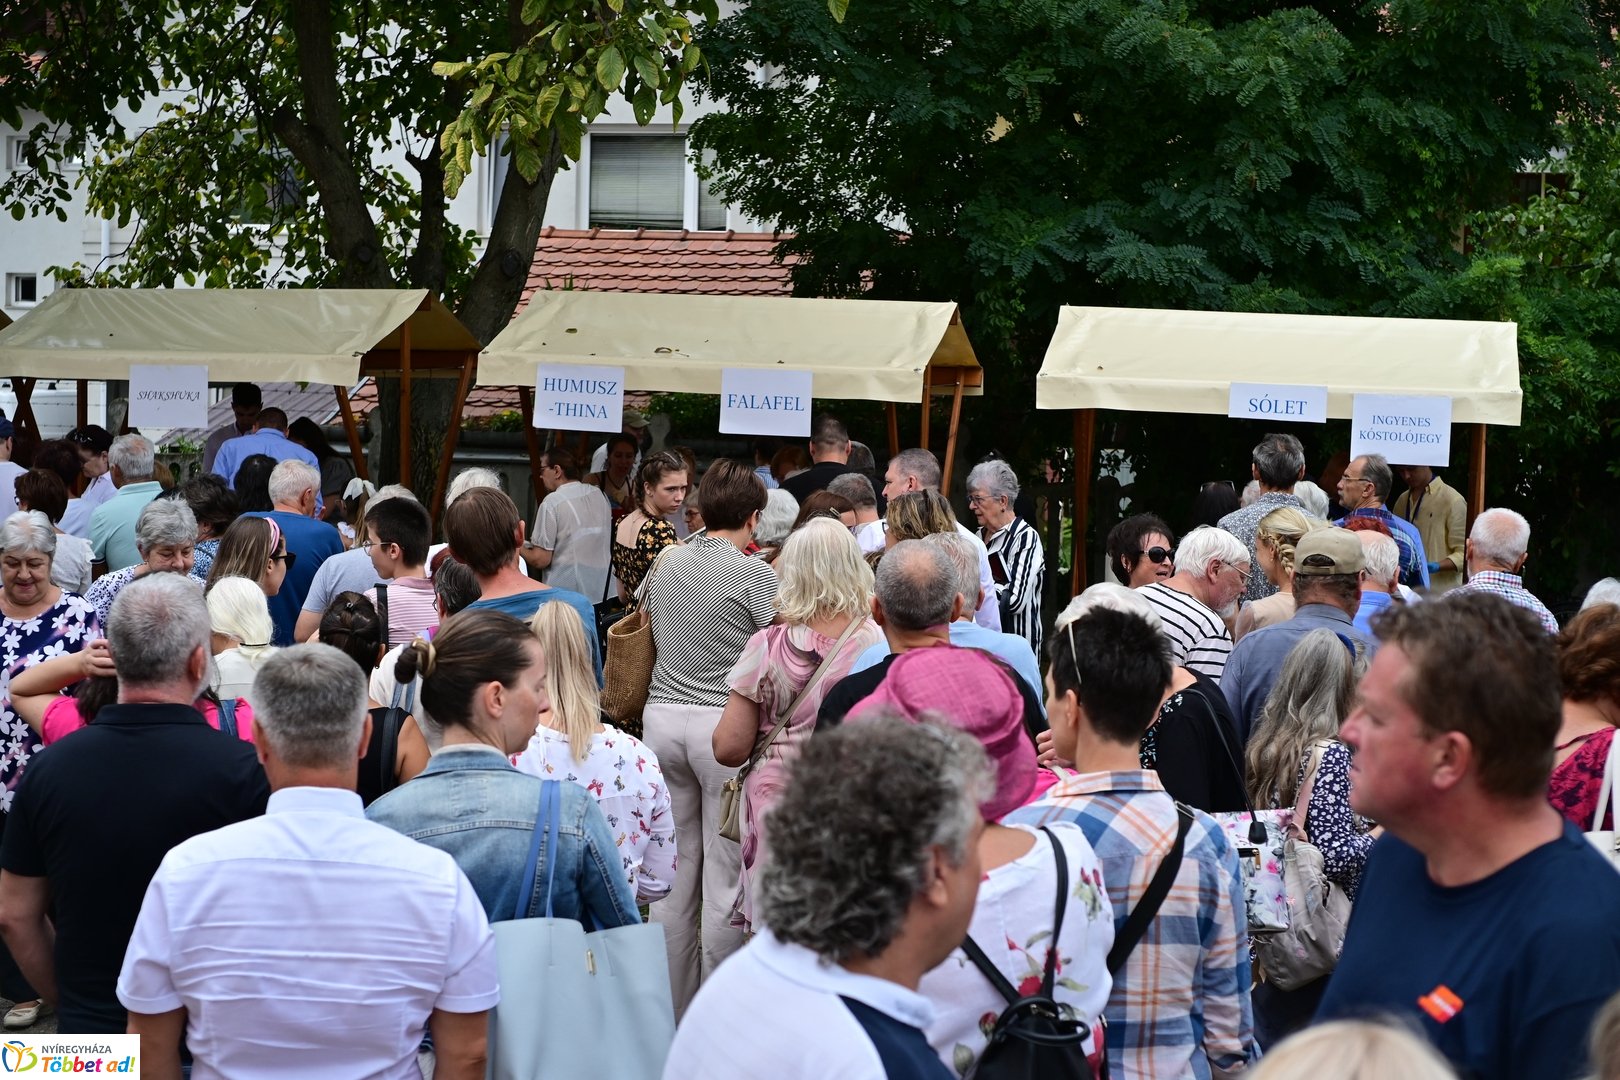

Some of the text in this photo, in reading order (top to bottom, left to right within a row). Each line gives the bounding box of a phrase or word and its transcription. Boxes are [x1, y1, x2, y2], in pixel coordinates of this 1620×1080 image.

[136, 389, 201, 402] SHAKSHUKA
[543, 377, 618, 396] HUMUSZ
[548, 401, 608, 419] -THINA
[727, 393, 805, 412] FALAFEL
[1248, 393, 1308, 416] SÓLET
[1372, 414, 1431, 428] INGYENES
[1359, 427, 1443, 445] KÓSTOLÓJEGY
